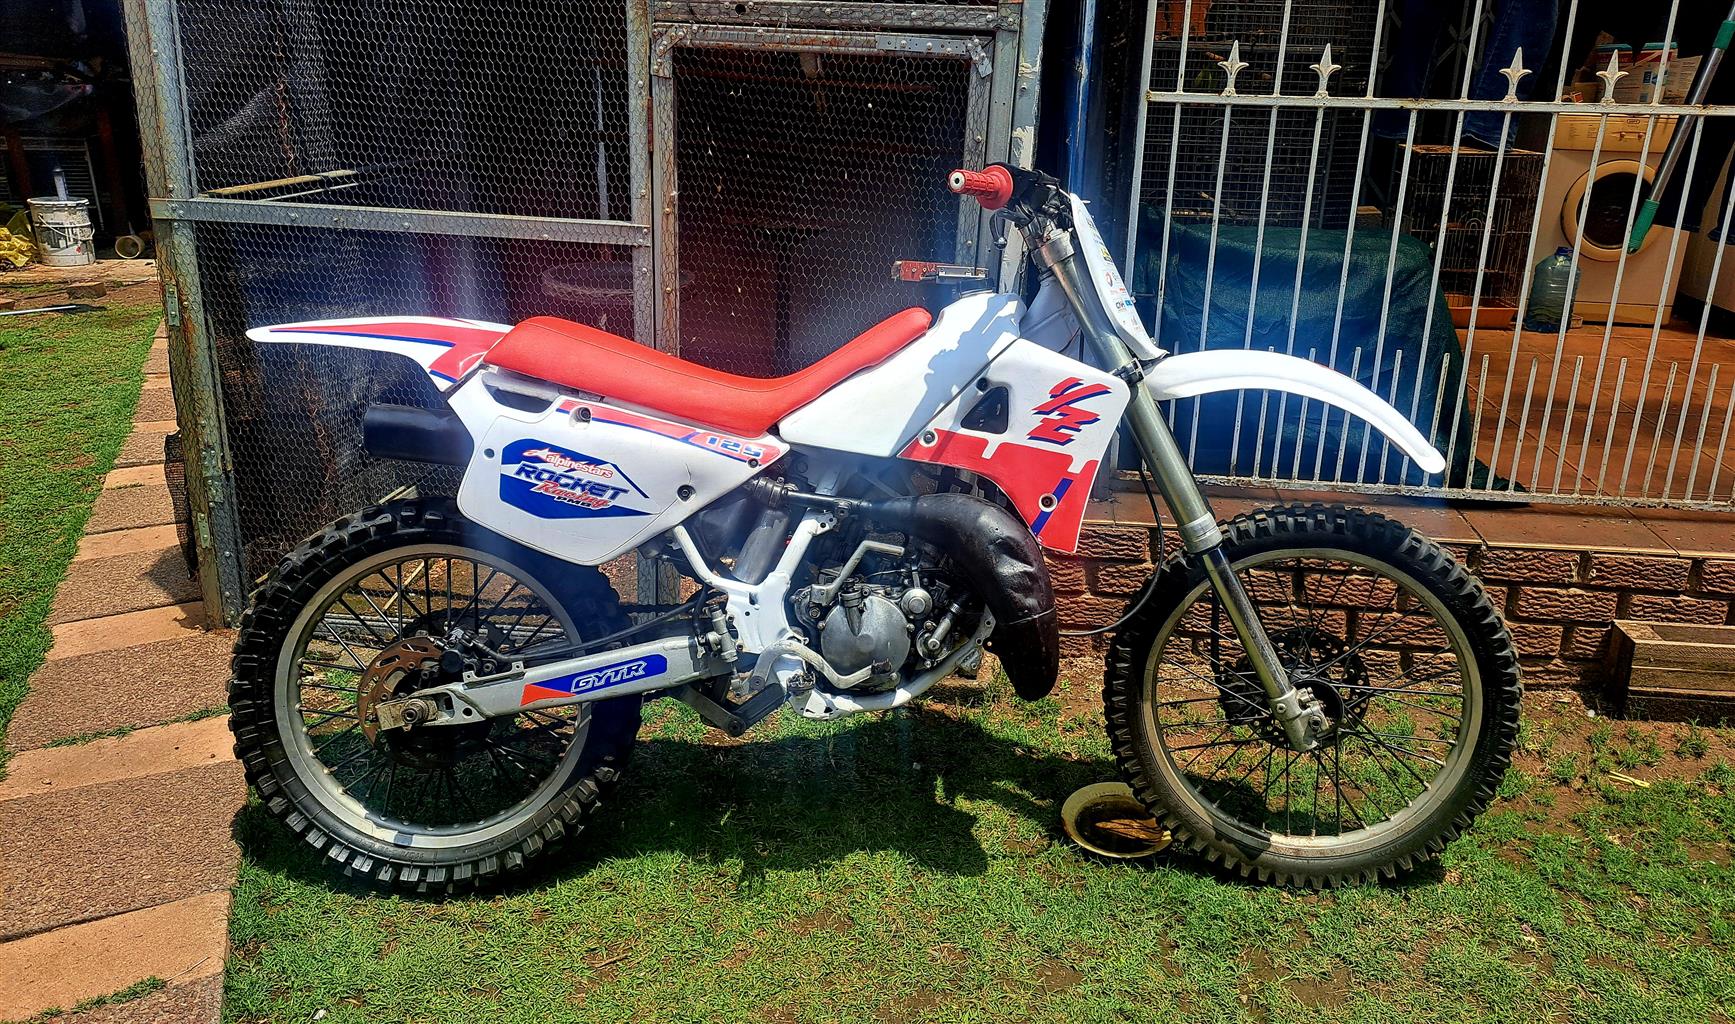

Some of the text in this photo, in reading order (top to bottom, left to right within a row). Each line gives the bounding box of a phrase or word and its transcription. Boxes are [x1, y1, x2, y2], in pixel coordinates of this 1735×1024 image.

[707, 436, 763, 458] 125
[546, 451, 614, 478] alpinestars
[514, 462, 630, 501] ROCKET
[571, 661, 647, 692] GYTR
